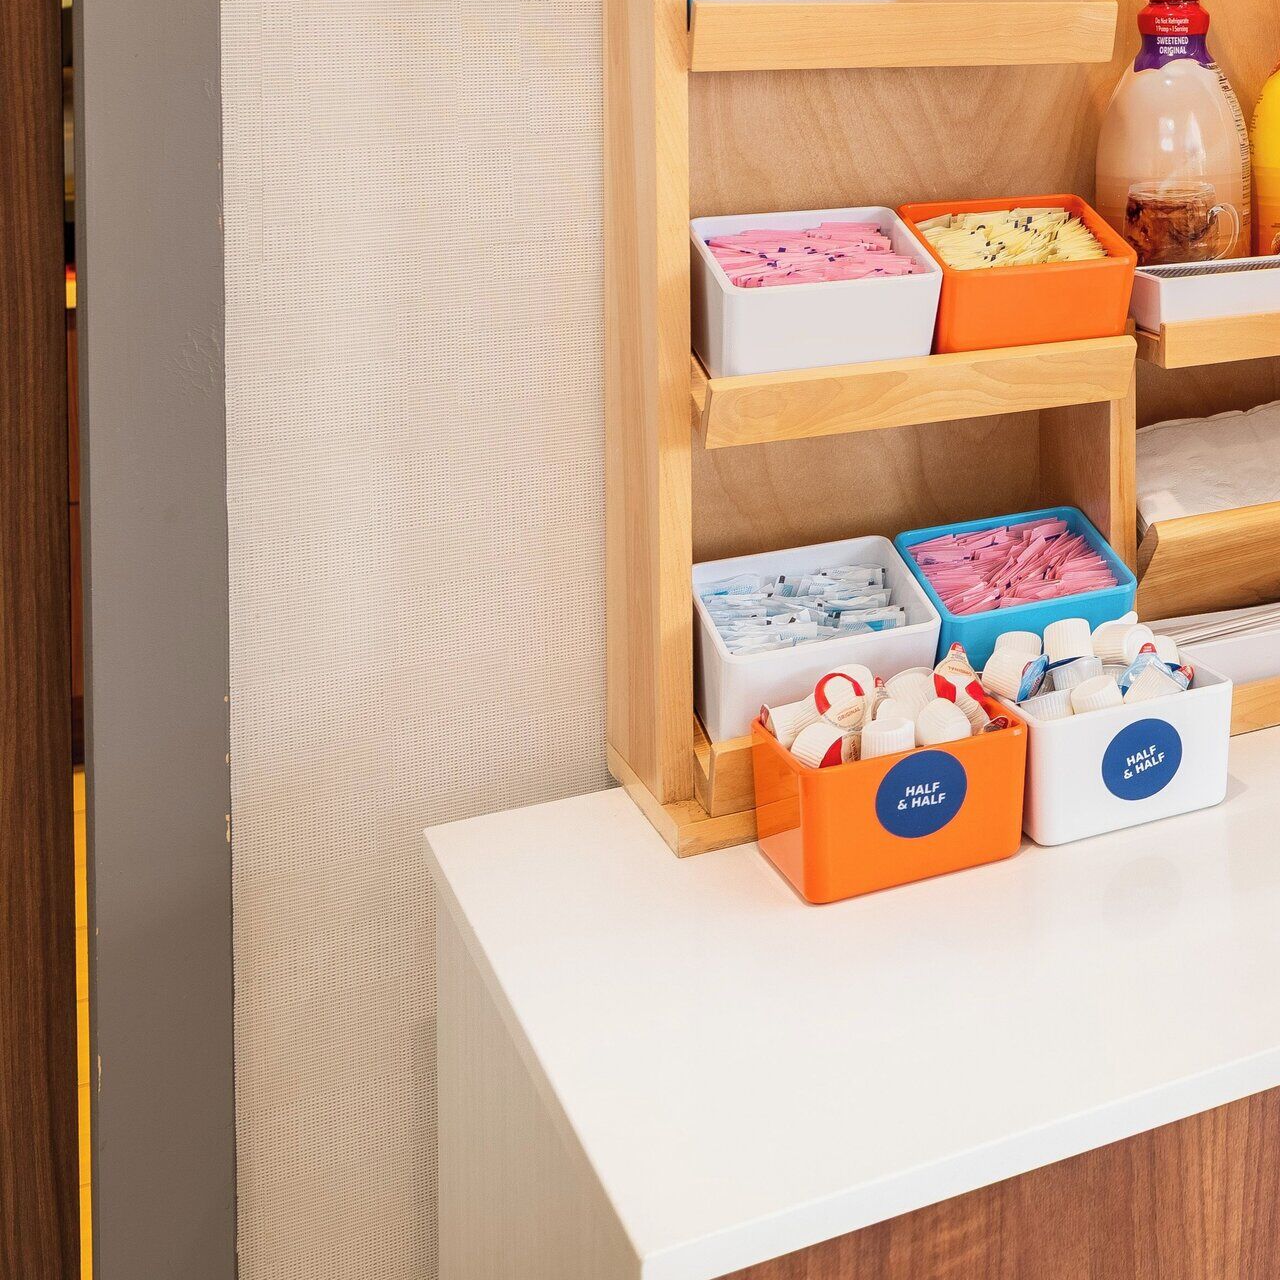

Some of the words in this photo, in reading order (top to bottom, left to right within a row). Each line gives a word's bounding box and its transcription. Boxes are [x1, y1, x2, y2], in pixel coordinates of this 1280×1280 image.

[1157, 36, 1189, 45] SWEETENED
[1159, 46, 1187, 55] ORIGINAL
[1126, 744, 1157, 767] HALF
[1123, 768, 1133, 780] &
[1135, 752, 1165, 774] HALF
[905, 781, 940, 797] HALF
[897, 799, 907, 810] &
[911, 792, 946, 808] HALF
